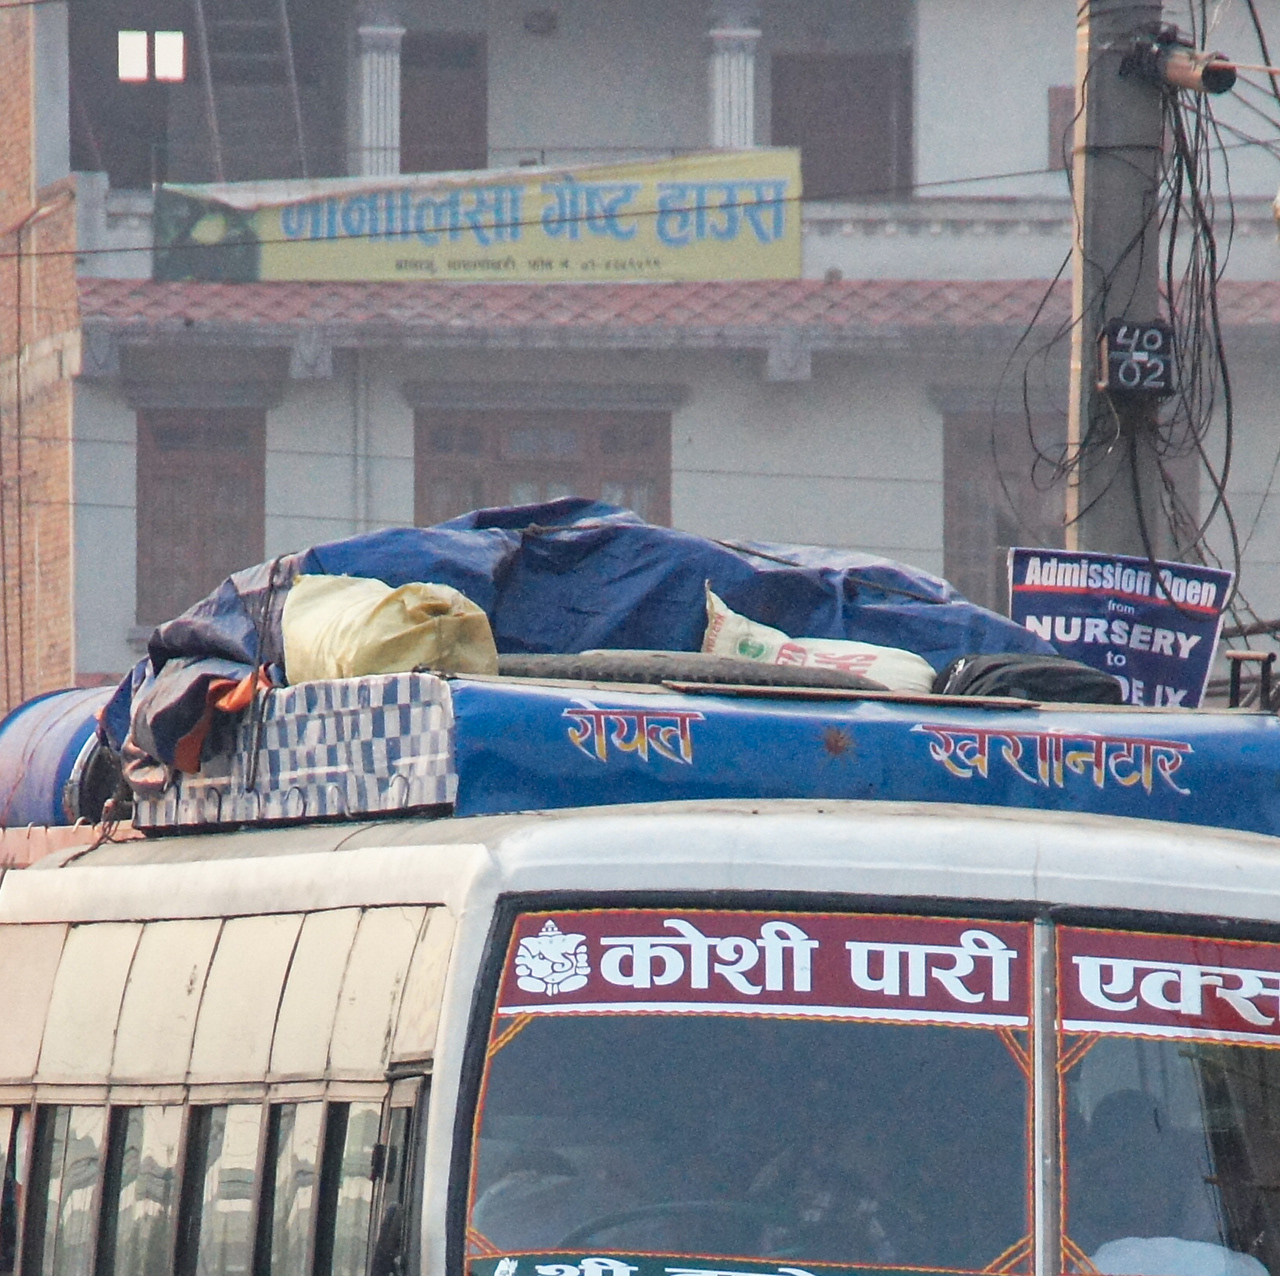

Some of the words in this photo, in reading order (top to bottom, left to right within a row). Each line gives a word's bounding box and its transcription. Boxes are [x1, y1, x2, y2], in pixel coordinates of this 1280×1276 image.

[656, 178, 788, 248] हाउस
[1116, 326, 1163, 351] 40
[1119, 358, 1165, 387] 02
[1025, 557, 1152, 597] Admission
[1155, 569, 1217, 608] Open
[1108, 600, 1135, 615] from
[1025, 614, 1202, 659] NURSERY
[1106, 651, 1127, 667] to
[599, 918, 819, 996] कोशी
[846, 929, 1018, 1004] पारी
